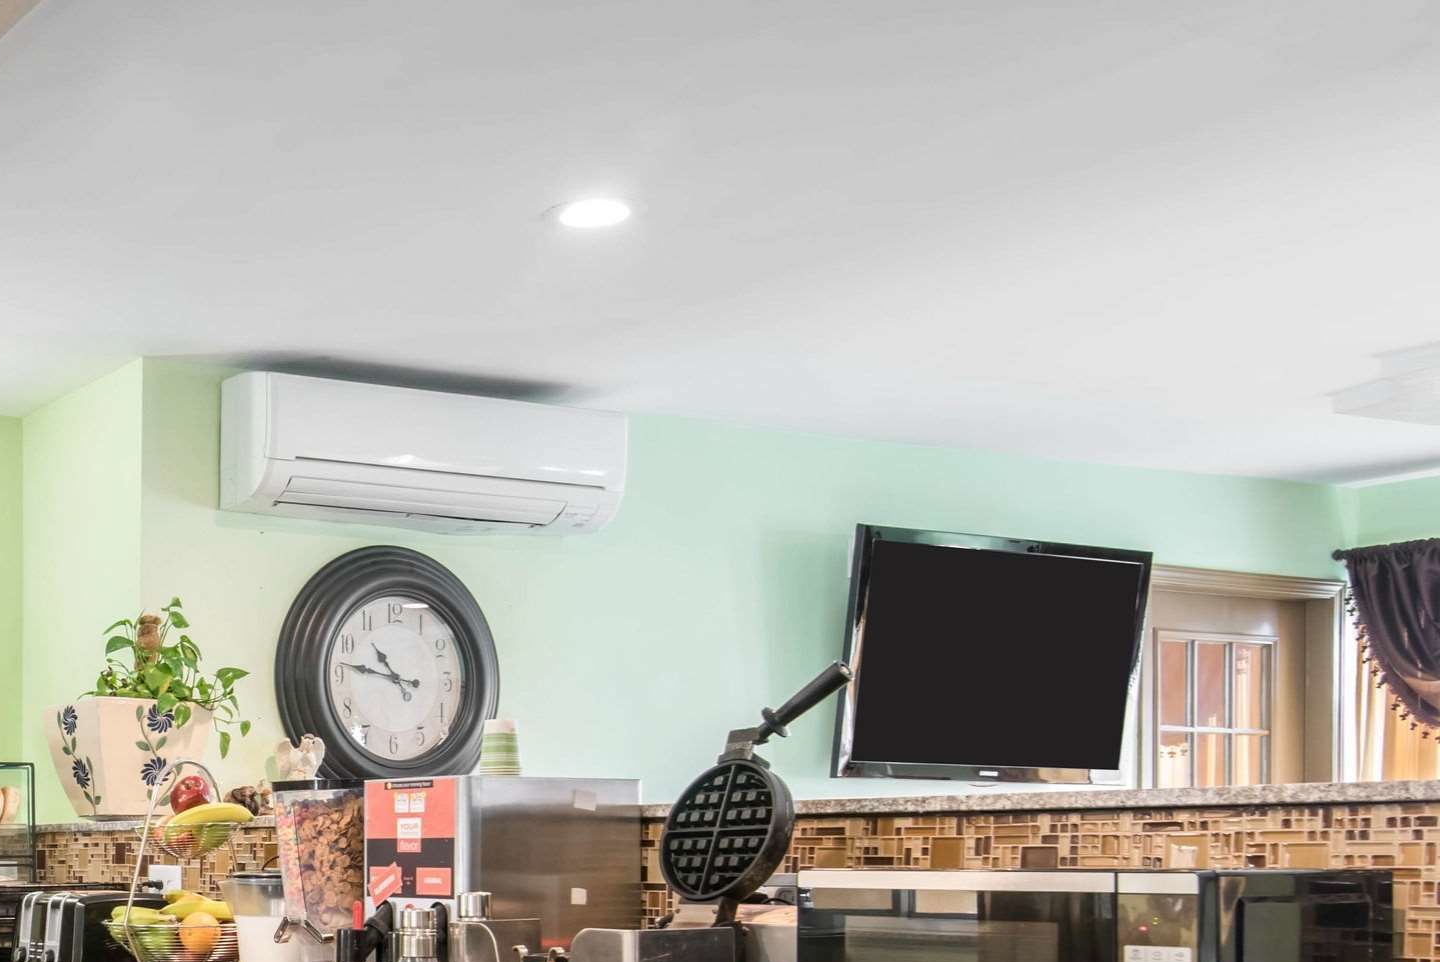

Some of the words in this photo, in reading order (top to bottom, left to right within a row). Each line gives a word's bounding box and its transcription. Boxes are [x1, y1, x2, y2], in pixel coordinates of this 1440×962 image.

[362, 609, 372, 631] 11
[387, 603, 403, 624] 12
[418, 614, 423, 635] 1
[340, 633, 355, 654] 10
[334, 664, 344, 684] 9
[442, 671, 453, 692] 3
[343, 697, 352, 718] 8
[388, 735, 399, 755] 6
[416, 726, 425, 746] 5
